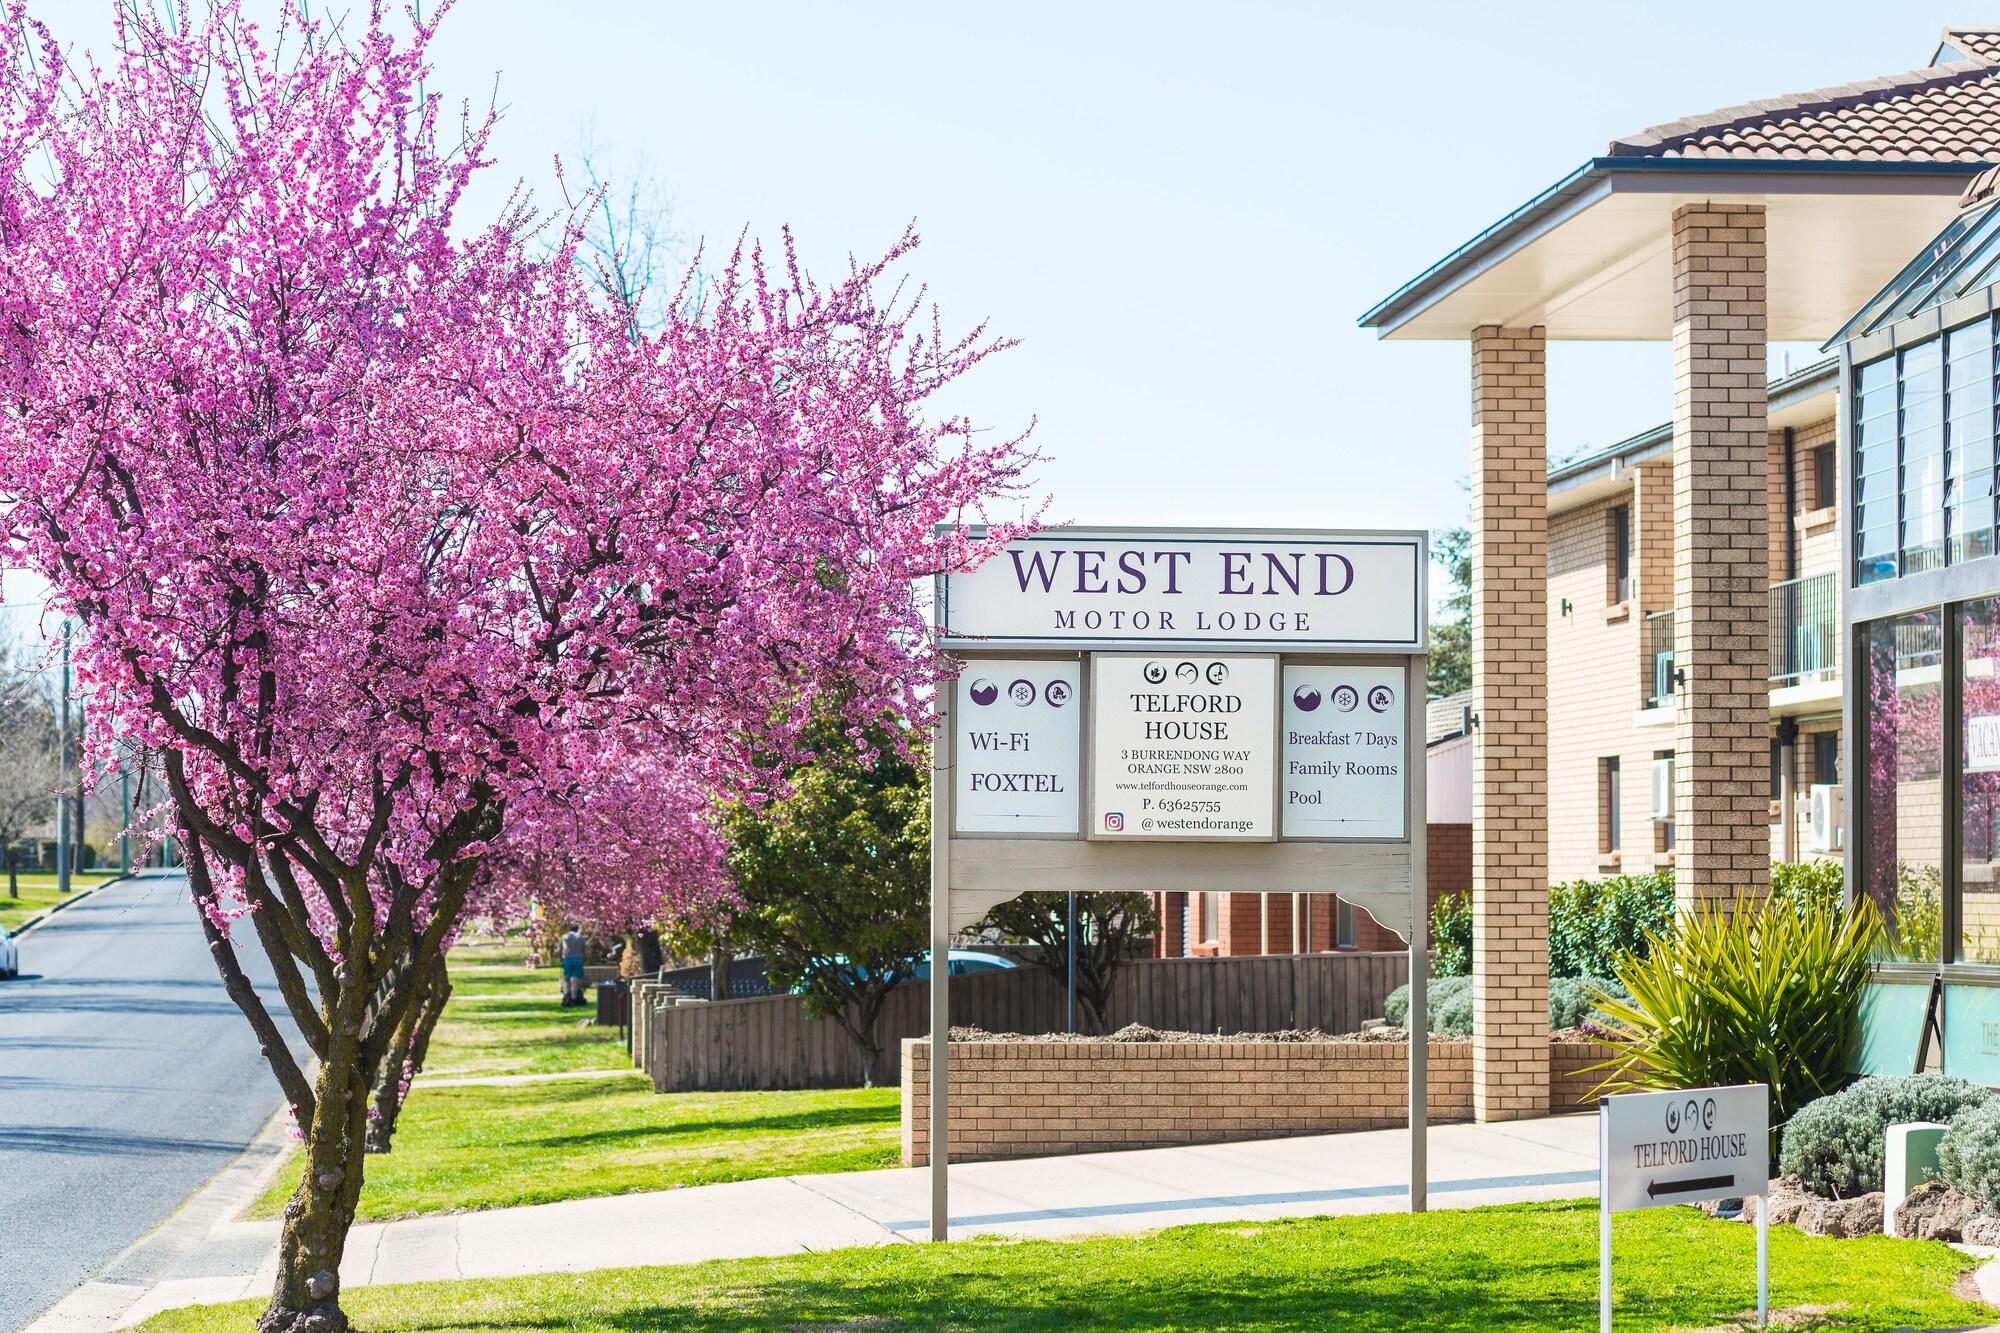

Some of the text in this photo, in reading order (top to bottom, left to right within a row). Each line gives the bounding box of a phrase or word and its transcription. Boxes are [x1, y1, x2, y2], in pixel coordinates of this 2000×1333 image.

[1007, 549, 1354, 596] WEST END
[1054, 610, 1310, 632] MOTOR LODGE
[1130, 694, 1242, 713] TELFORD
[1145, 721, 1228, 740] HOUSE
[969, 732, 1030, 751] Wi-Fi
[1289, 731, 1398, 748] Breakfast 7 Days
[1121, 750, 1251, 761] 3 BURRENDONG WAY
[1128, 763, 1243, 775] ORANGE NSW 2800
[1289, 761, 1398, 778] Family Rooms
[971, 773, 1064, 793] FOXTEL
[1115, 781, 1248, 791] www.telfordhouseorange.com
[1143, 798, 1221, 812] P. 63625755
[1289, 790, 1322, 805] Pool
[1141, 818, 1253, 832] @ westendorange
[1634, 1133, 1747, 1169] TELFORD HOUSE
